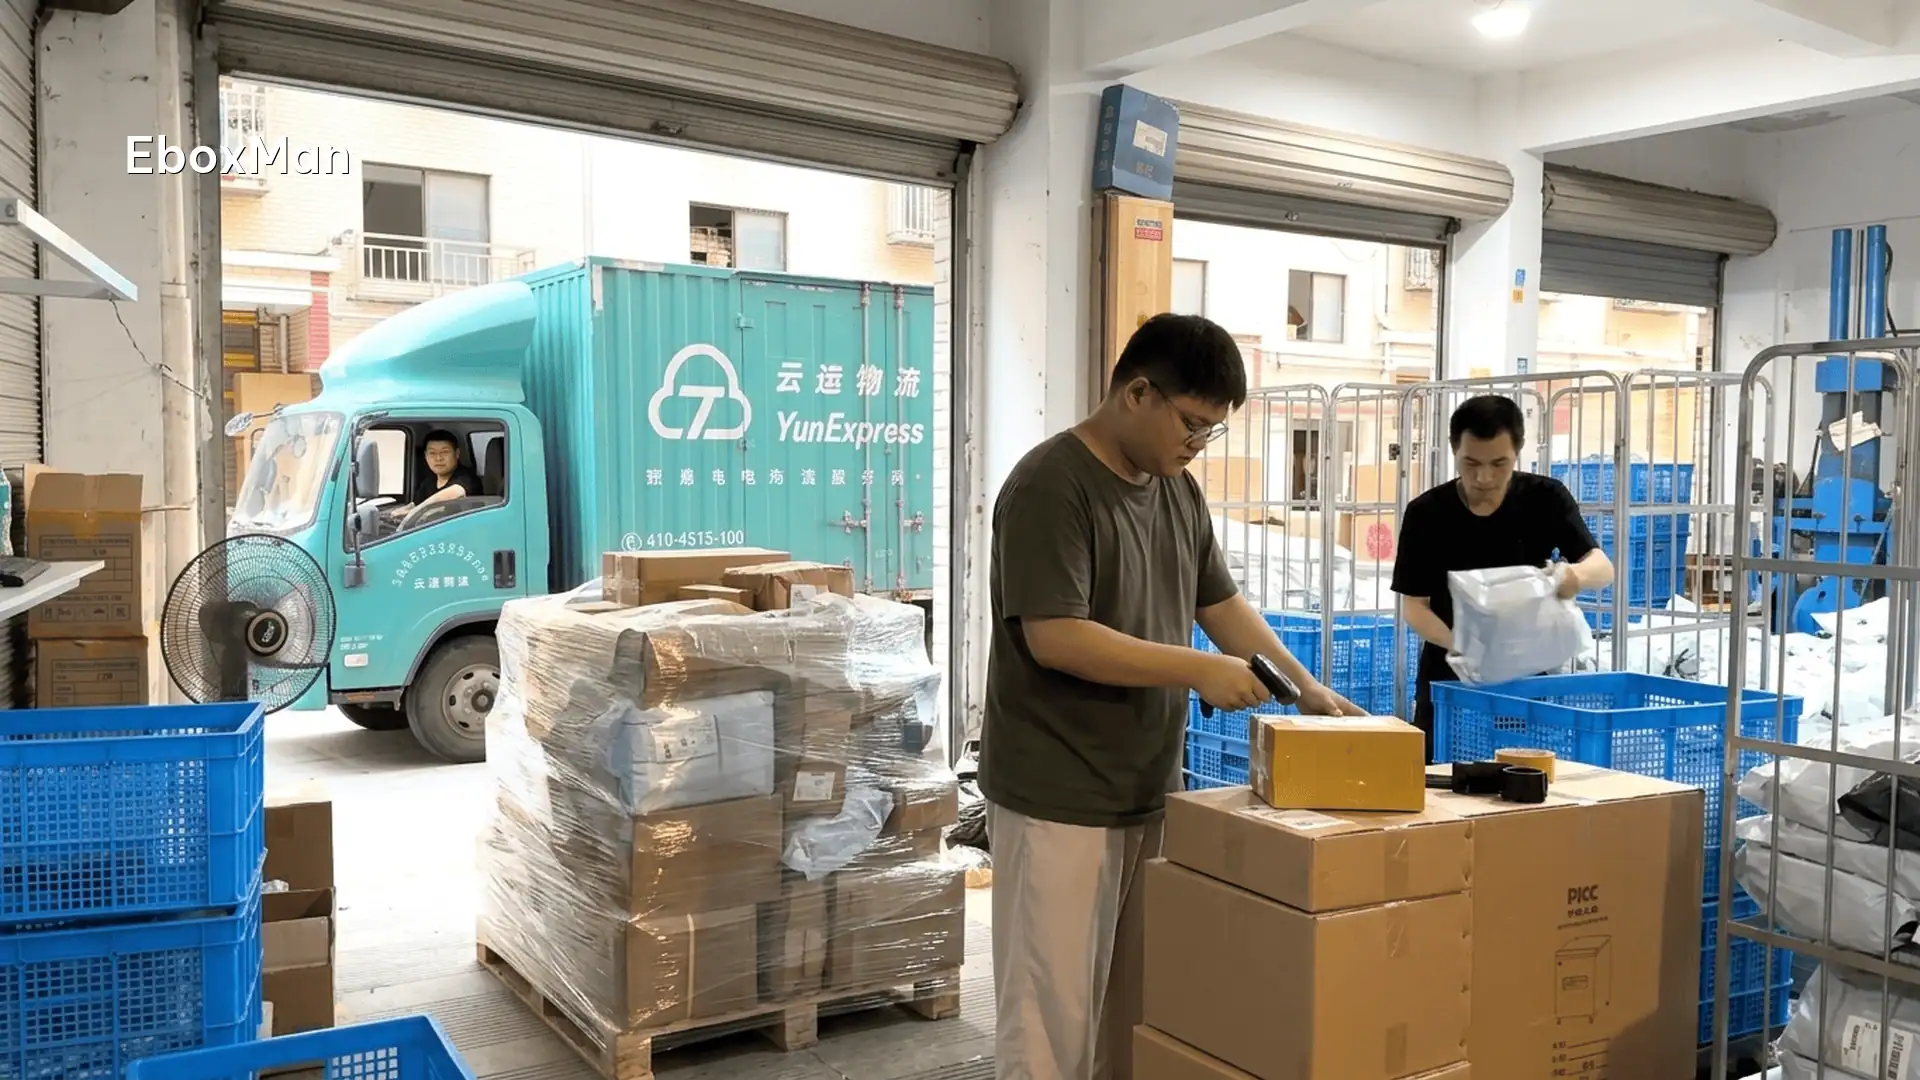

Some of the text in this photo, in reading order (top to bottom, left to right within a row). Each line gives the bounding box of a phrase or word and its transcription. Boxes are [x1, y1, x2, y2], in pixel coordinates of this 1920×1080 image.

[776, 361, 921, 398] 云运物流
[776, 411, 925, 450] YunExpress
